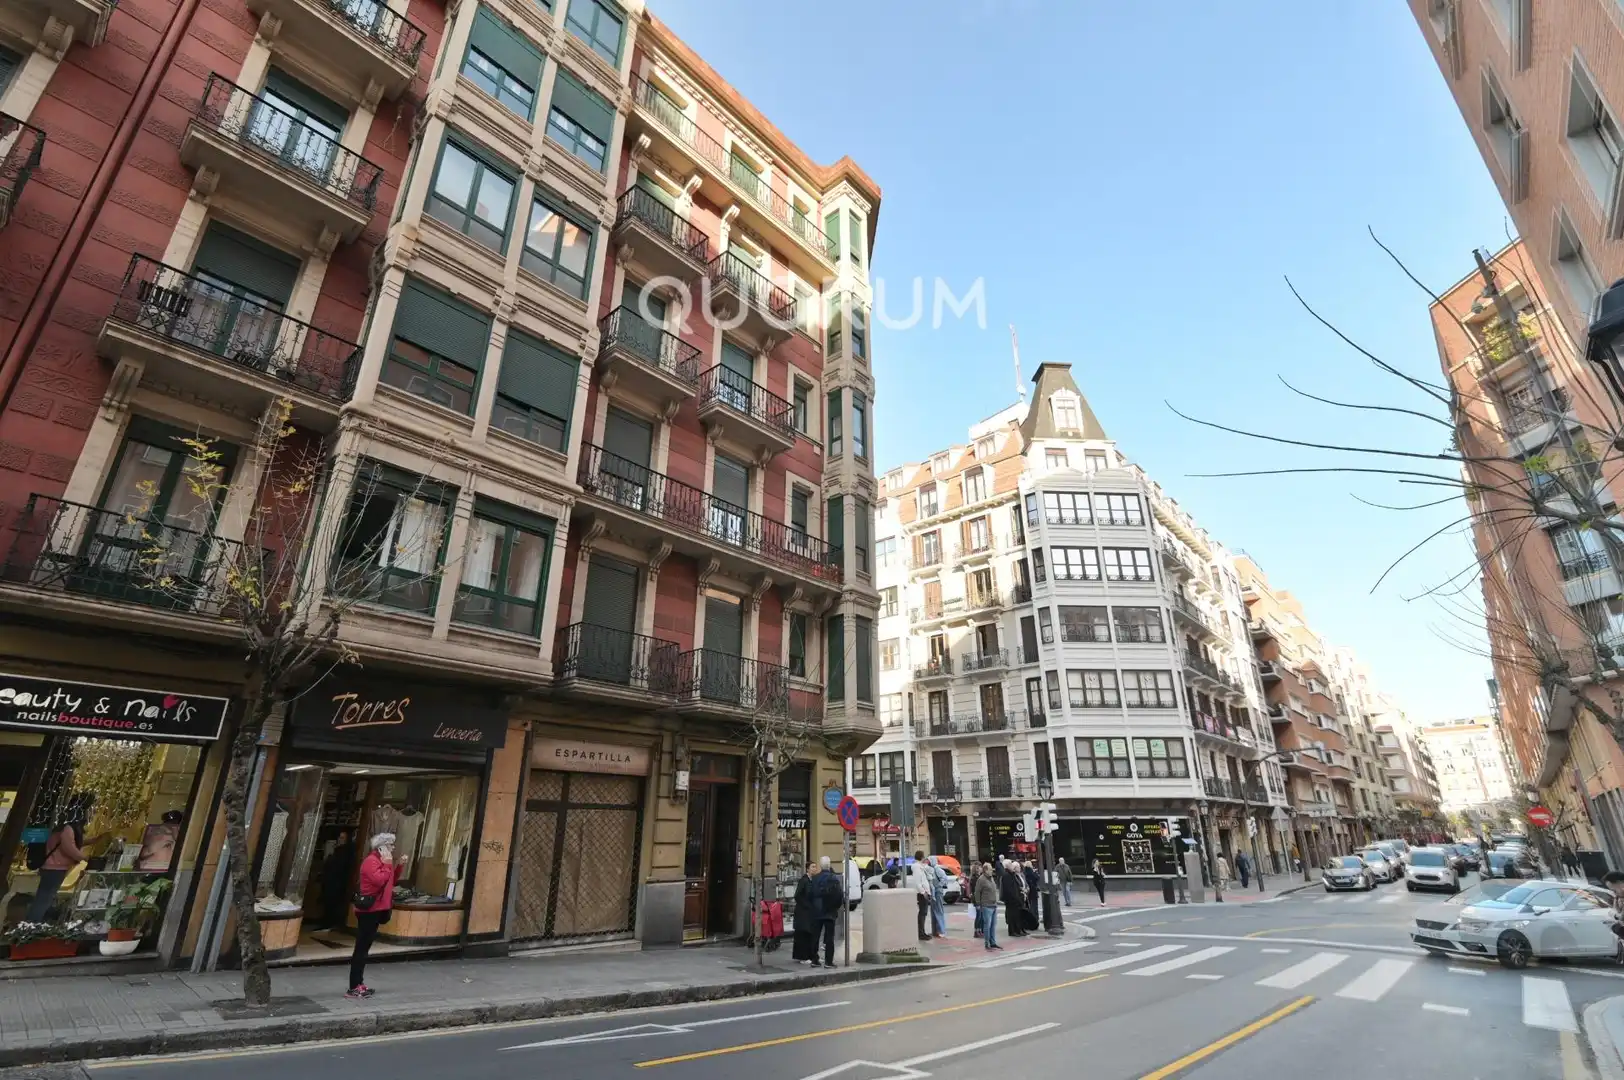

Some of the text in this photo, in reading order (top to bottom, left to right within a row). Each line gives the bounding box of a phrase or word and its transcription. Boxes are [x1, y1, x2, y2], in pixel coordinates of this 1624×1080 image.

[0, 687, 197, 722] eauty & nails
[331, 692, 411, 730] Torres
[16, 710, 154, 730] nailsboutique.es
[555, 748, 632, 763] ESPARTILLA
[777, 818, 807, 829] OUTLET
